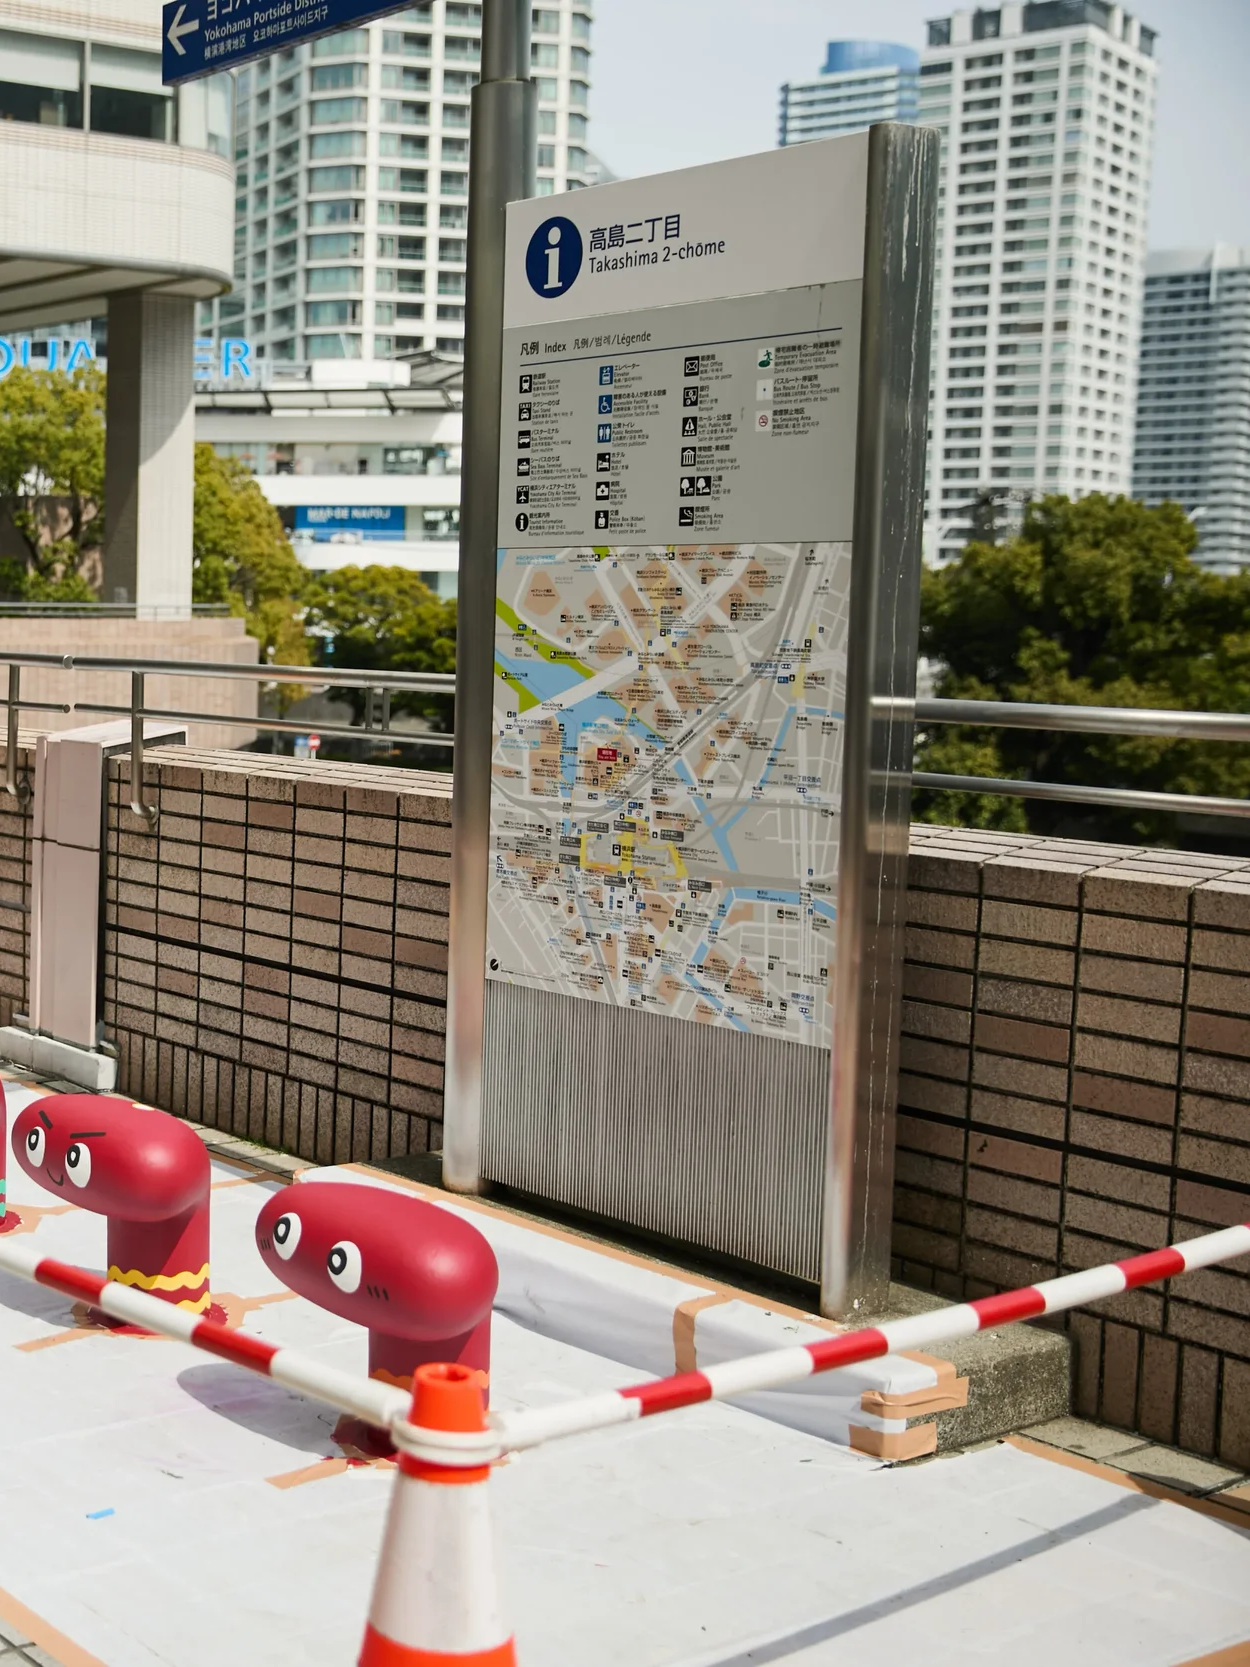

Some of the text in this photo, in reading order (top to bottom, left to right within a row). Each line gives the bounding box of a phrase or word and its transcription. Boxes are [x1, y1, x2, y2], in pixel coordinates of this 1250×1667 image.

[204, 18, 251, 42] Yokohama
[254, 3, 291, 25] Portside
[589, 214, 681, 252] 高島二丁目
[589, 241, 725, 273] Takashima 2-chōme
[520, 341, 539, 356] 凡例
[545, 342, 567, 353] Index
